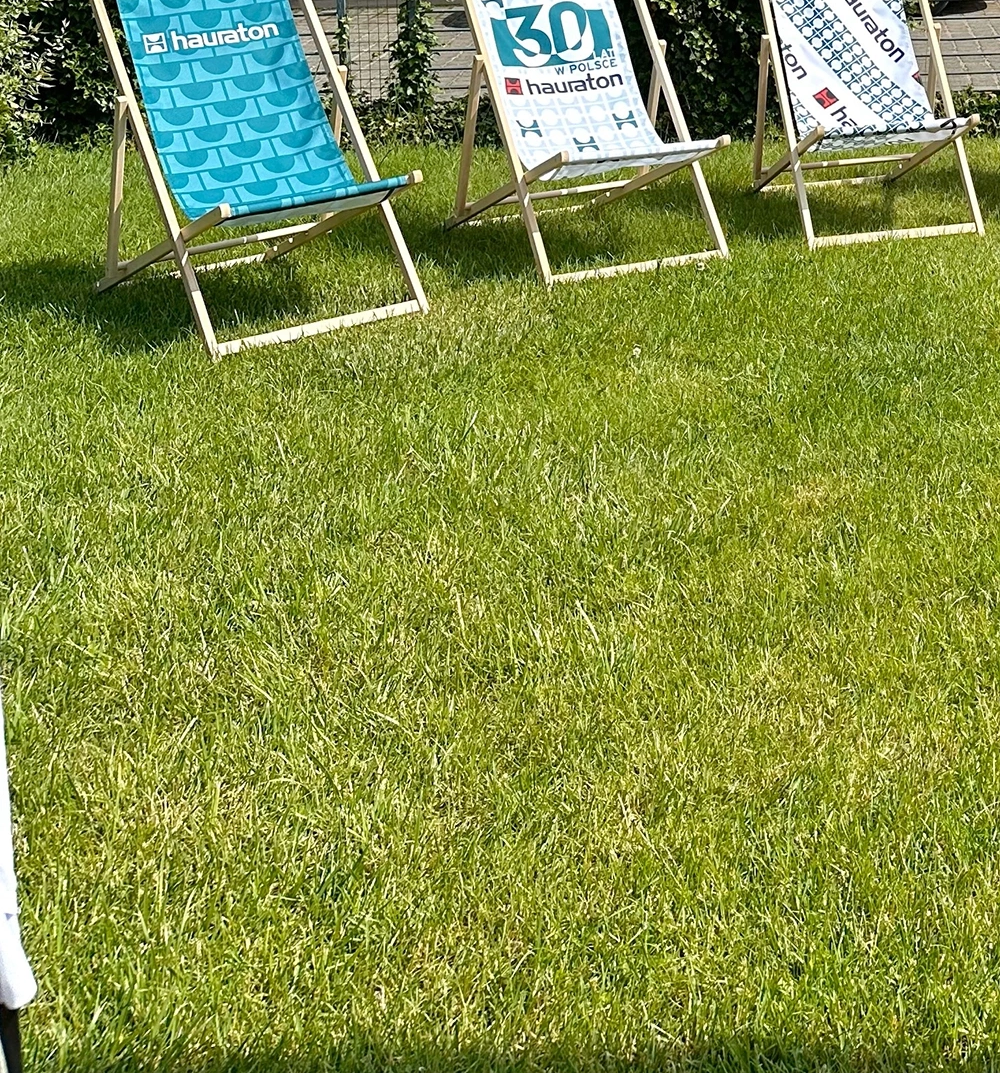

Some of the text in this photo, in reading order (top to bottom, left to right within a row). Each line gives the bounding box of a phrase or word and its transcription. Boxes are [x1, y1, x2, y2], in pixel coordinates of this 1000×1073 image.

[170, 22, 280, 51] hauraton
[505, 0, 595, 69] 30
[554, 58, 618, 76] W POLSCE
[525, 73, 624, 95] hauraton
